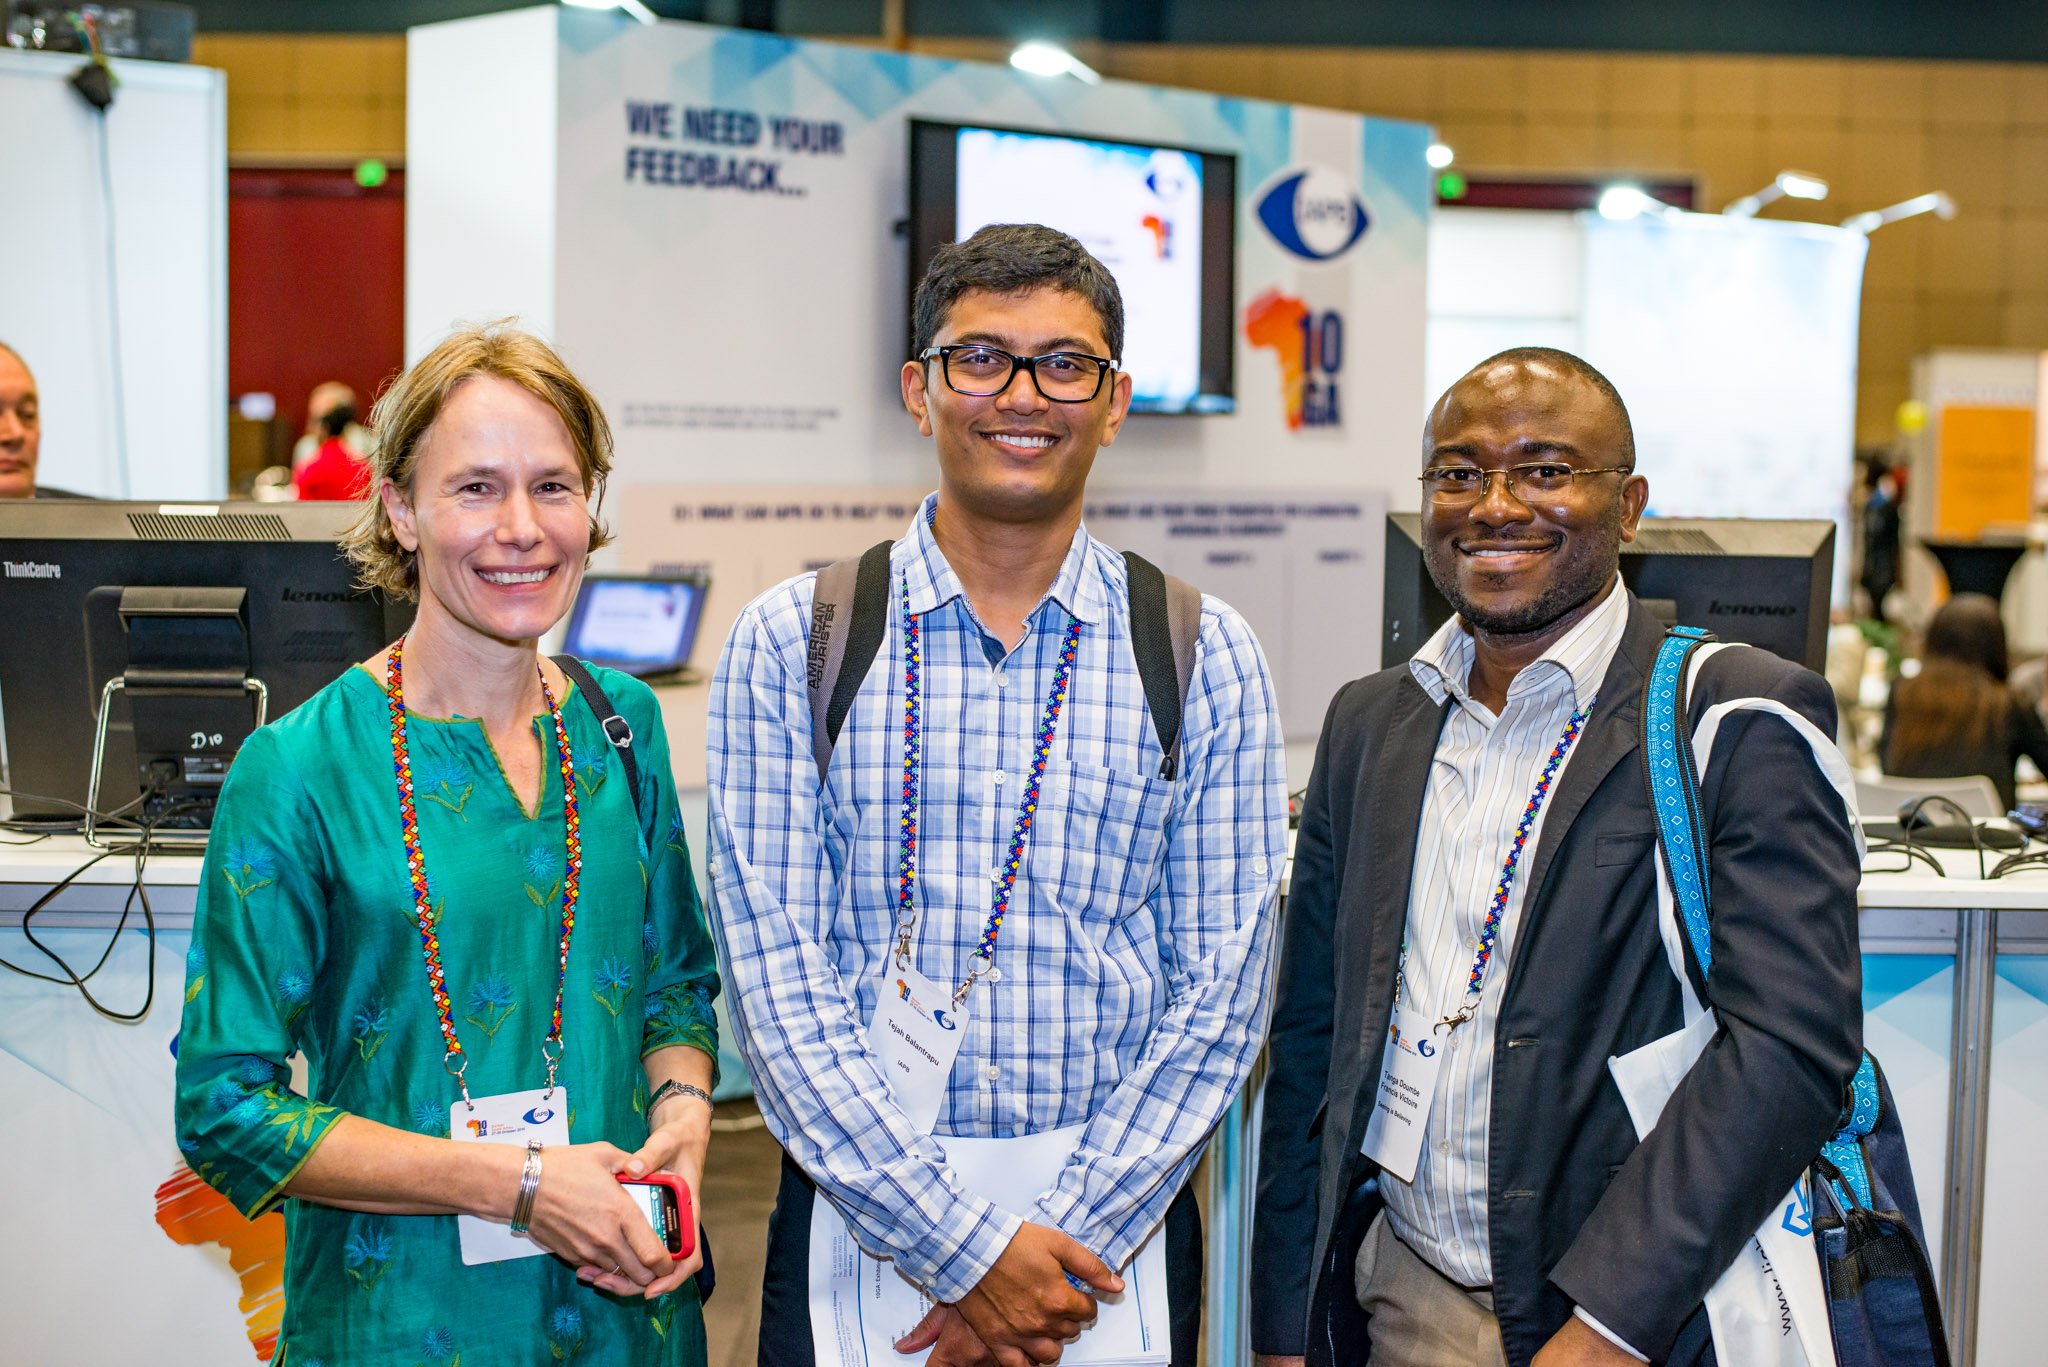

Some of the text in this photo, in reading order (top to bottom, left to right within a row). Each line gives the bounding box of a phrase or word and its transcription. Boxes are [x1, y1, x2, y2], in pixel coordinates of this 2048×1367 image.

[626, 102, 844, 154] WE NEED YOUR
[3, 560, 61, 579] ThinkCentre
[1708, 600, 1797, 616] lenovo
[807, 602, 827, 690] AMERICAN
[888, 1017, 940, 1066] Tejah Balantrapu
[897, 1059, 910, 1073] IAPB
[1384, 1070, 1399, 1086] Tanga
